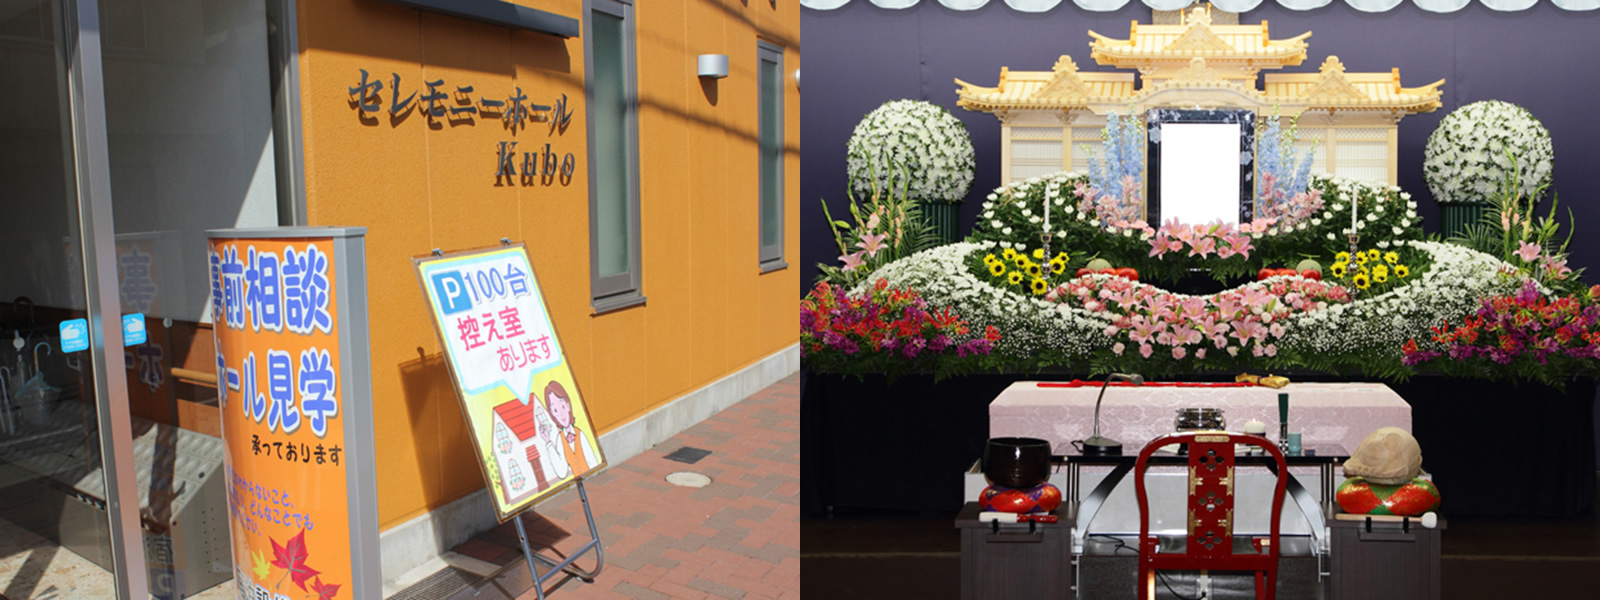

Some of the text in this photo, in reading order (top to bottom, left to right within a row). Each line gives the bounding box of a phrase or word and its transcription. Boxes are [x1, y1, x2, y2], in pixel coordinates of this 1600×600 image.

[348, 69, 574, 127] セレモニーホール
[496, 141, 575, 178] Kubo
[210, 243, 332, 333] 事前相談
[464, 263, 529, 302] 100台
[457, 306, 525, 351] 控え室
[497, 334, 550, 372] あります
[252, 435, 342, 466] 承っております
